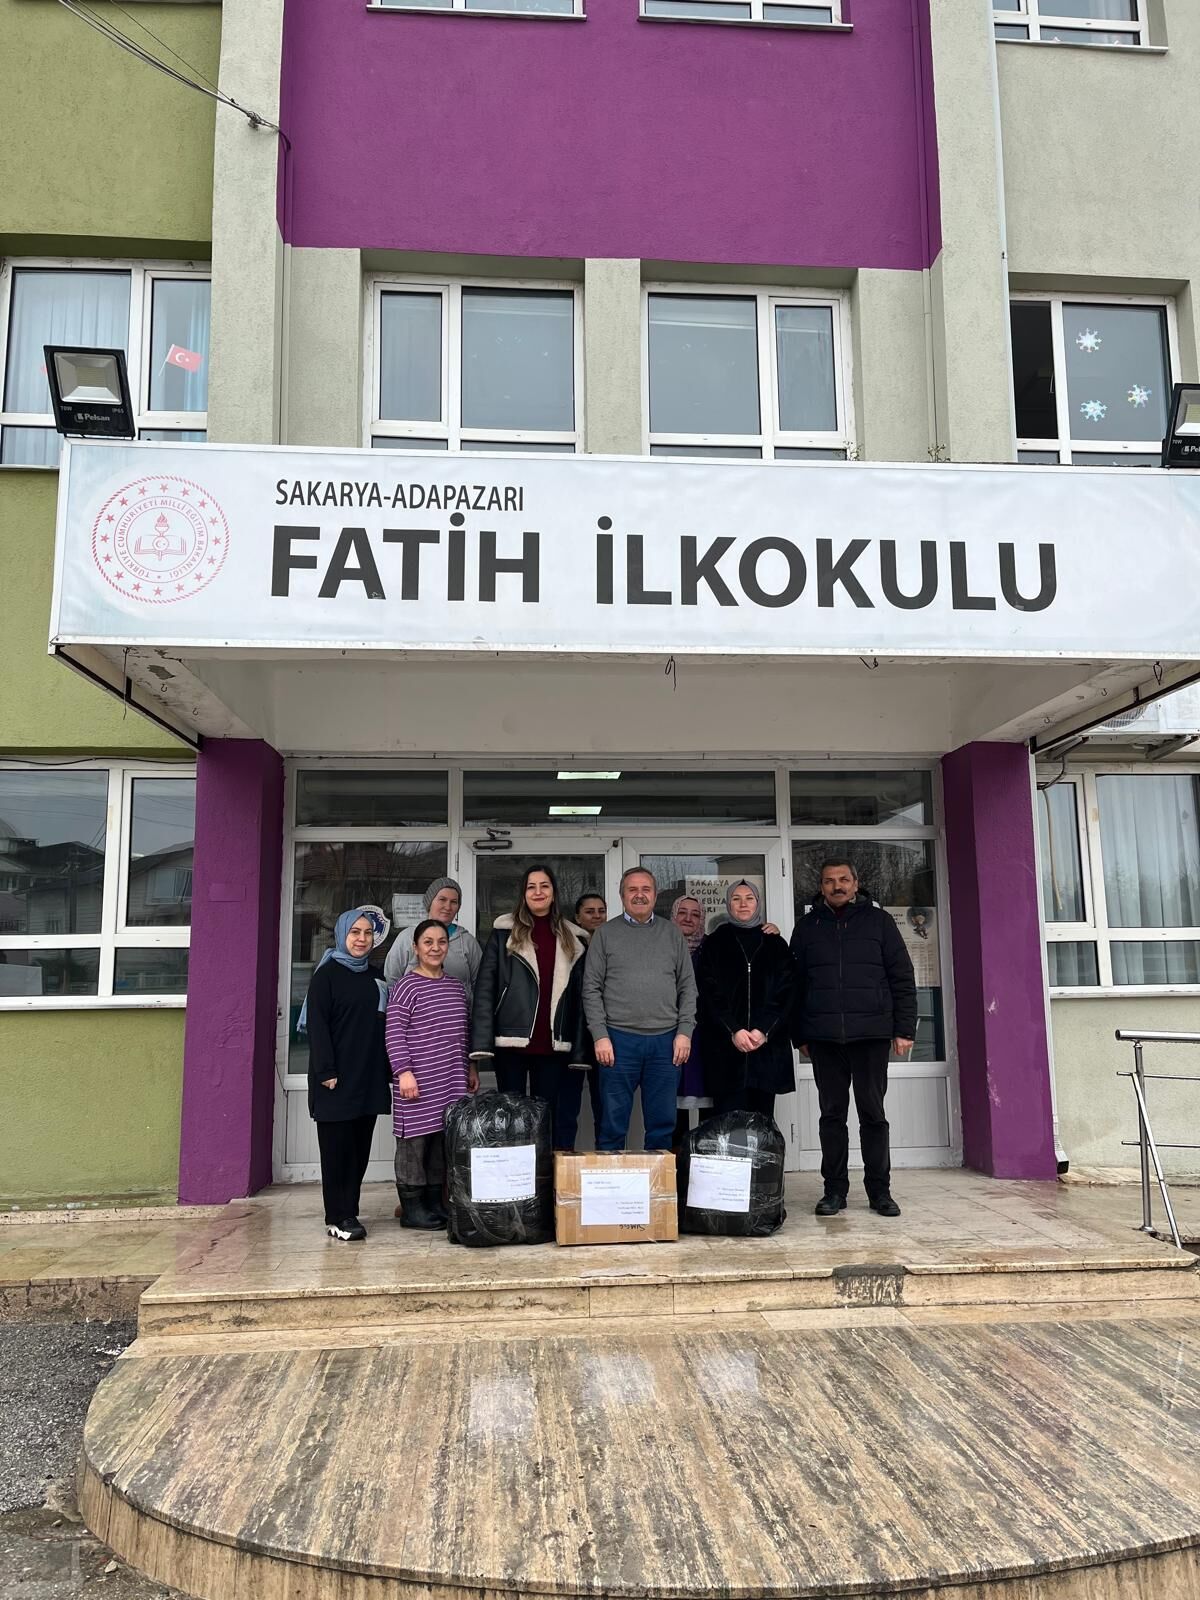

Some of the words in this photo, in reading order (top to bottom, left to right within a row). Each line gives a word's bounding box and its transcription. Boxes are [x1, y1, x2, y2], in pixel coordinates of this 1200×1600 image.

[84, 413, 111, 421] Pelsan
[276, 479, 523, 511] SAKARYA-ADAPAZARI
[117, 499, 158, 548] CUMHURİYETİ
[160, 499, 187, 511] MİLLİ
[186, 508, 205, 538] EĞİTİM
[272, 513, 540, 602] FATİH
[597, 515, 1057, 612] İLKOKULU
